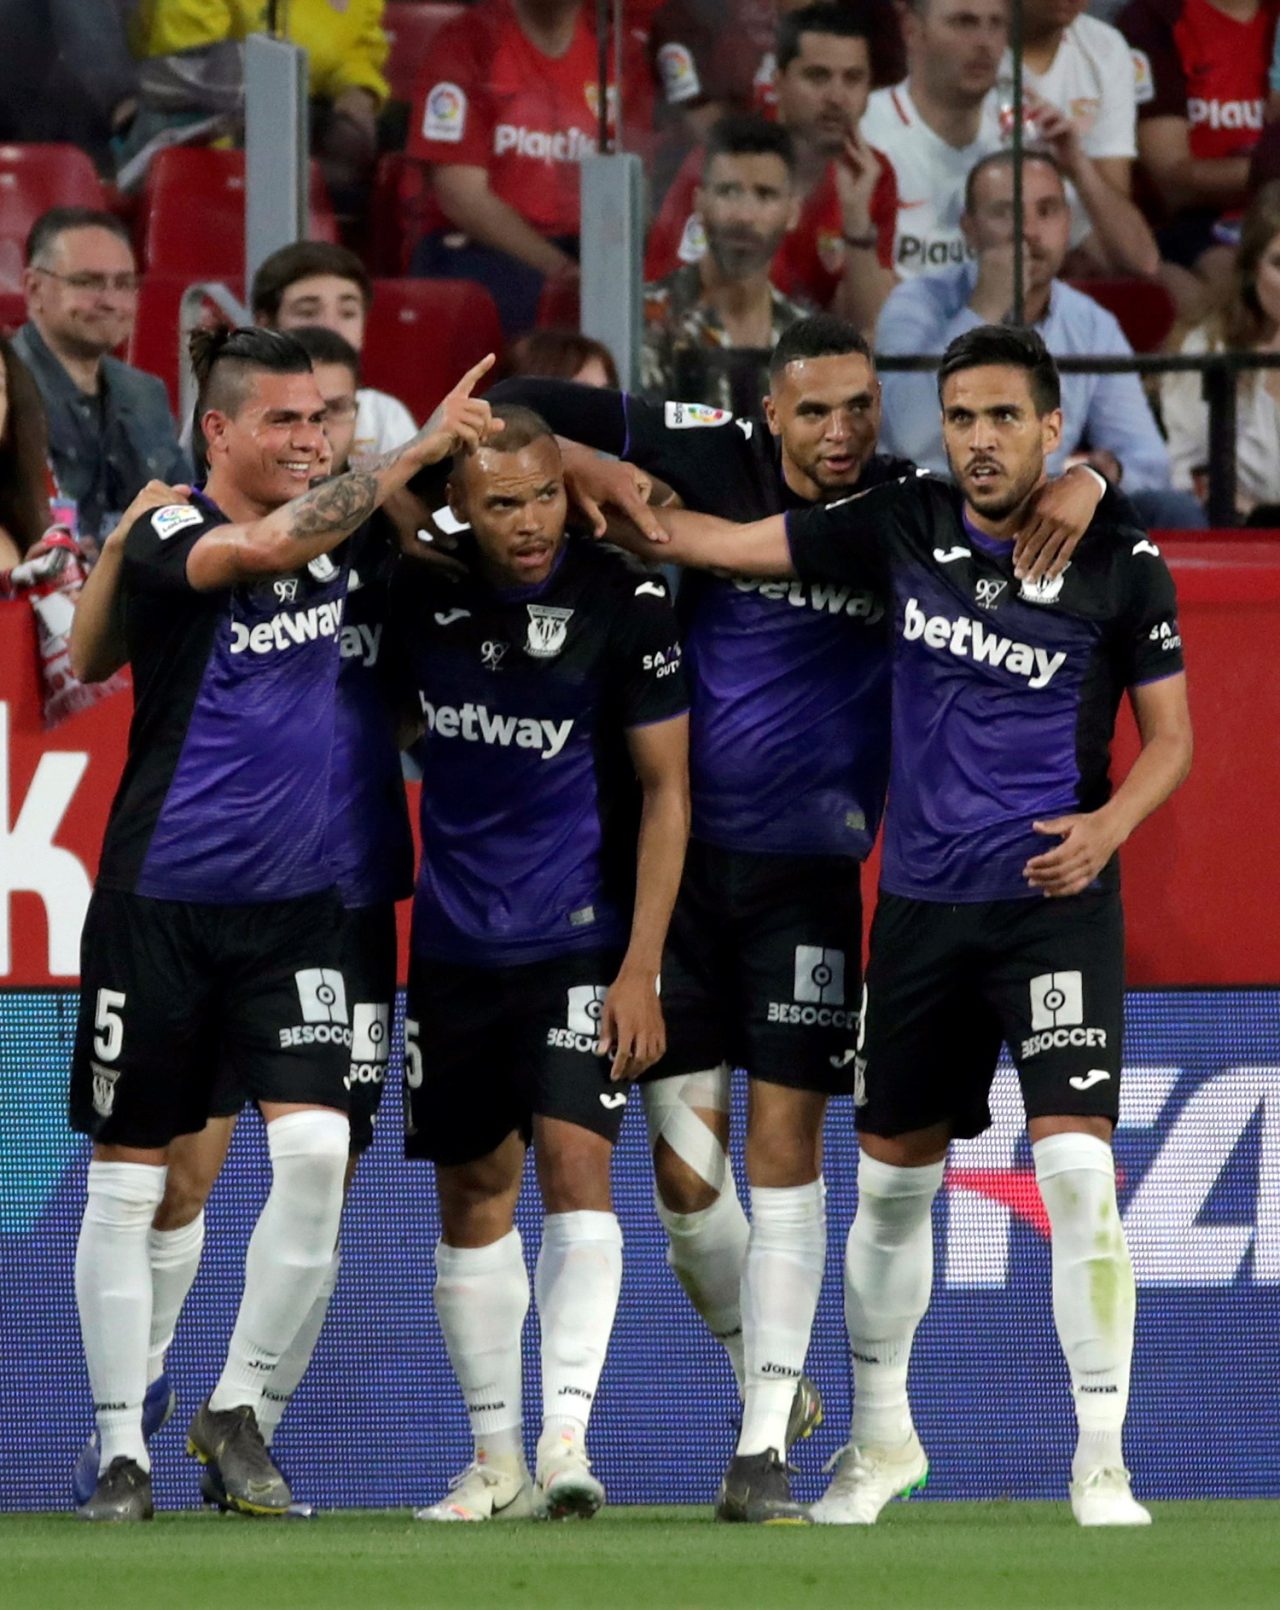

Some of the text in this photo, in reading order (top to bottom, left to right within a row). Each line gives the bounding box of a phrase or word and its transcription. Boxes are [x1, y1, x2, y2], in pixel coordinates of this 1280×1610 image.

[903, 598, 1067, 689] betway
[93, 988, 126, 1062] 5
[1021, 1028, 1107, 1060] BESOCCER
